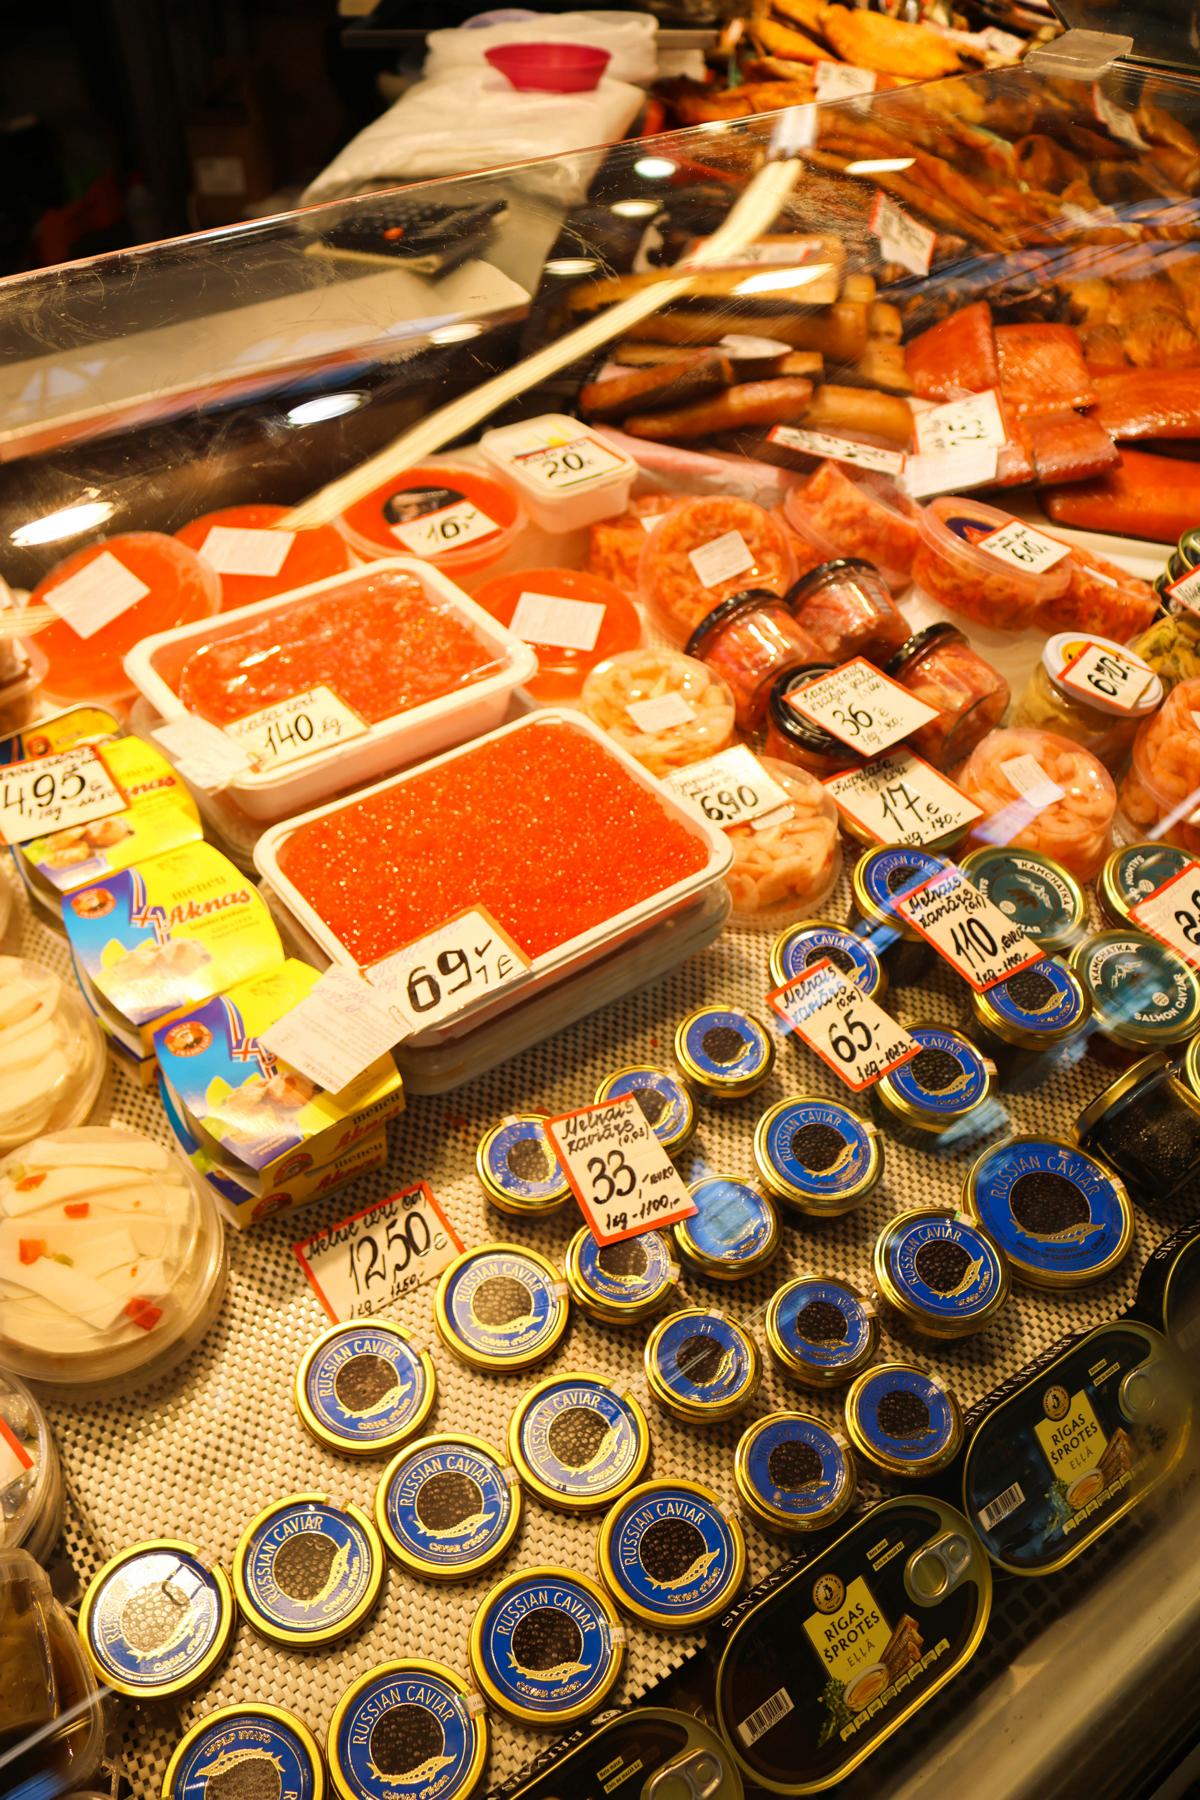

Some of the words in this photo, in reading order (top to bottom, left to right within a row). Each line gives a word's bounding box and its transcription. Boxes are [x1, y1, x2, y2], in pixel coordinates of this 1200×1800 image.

[265, 713, 314, 755] 140
[1021, 861, 1072, 906] KAMCHATKA
[166, 889, 252, 929] Aknas
[1090, 944, 1133, 982] KAMCHATKA
[1134, 1007, 1180, 1023] SALMON
[1175, 973, 1187, 1009] CAVIAR
[922, 1038, 963, 1056] CAVIAR
[779, 1120, 800, 1161] RUSSIAN
[800, 1111, 842, 1127] CAVIAR
[991, 1156, 1041, 1199] RUSSIAN
[1047, 1157, 1100, 1195] CAVIAR
[901, 1238, 920, 1285] RUSSIAN
[918, 1227, 962, 1241] CAVIAR
[457, 1262, 499, 1303] RUSSIAN
[503, 1263, 543, 1292] CAVIAR
[320, 1346, 352, 1397] RUSSIAN
[354, 1340, 401, 1362] CAVIAR
[532, 1408, 556, 1464] RUSSIAN
[553, 1391, 601, 1410] CAVIAR
[1051, 1413, 1085, 1446] RĪGAS
[1051, 1422, 1099, 1465] ŠPROTES
[400, 1458, 443, 1506] RUSSIAN
[446, 1456, 492, 1486] CAVIAR
[623, 1509, 655, 1566] RUSSIAN
[656, 1502, 706, 1525] CAVIAR
[257, 1542, 280, 1605] RUSSIAN
[273, 1515, 324, 1541] CAVIAR
[497, 1590, 548, 1636] RUSSIAN
[553, 1592, 597, 1633] CAVIAR
[824, 1602, 866, 1644] RĪGAS
[824, 1610, 881, 1664] ŠPROTES
[353, 1687, 401, 1745] RUSSIAN
[406, 1685, 455, 1722] CAVIAR
